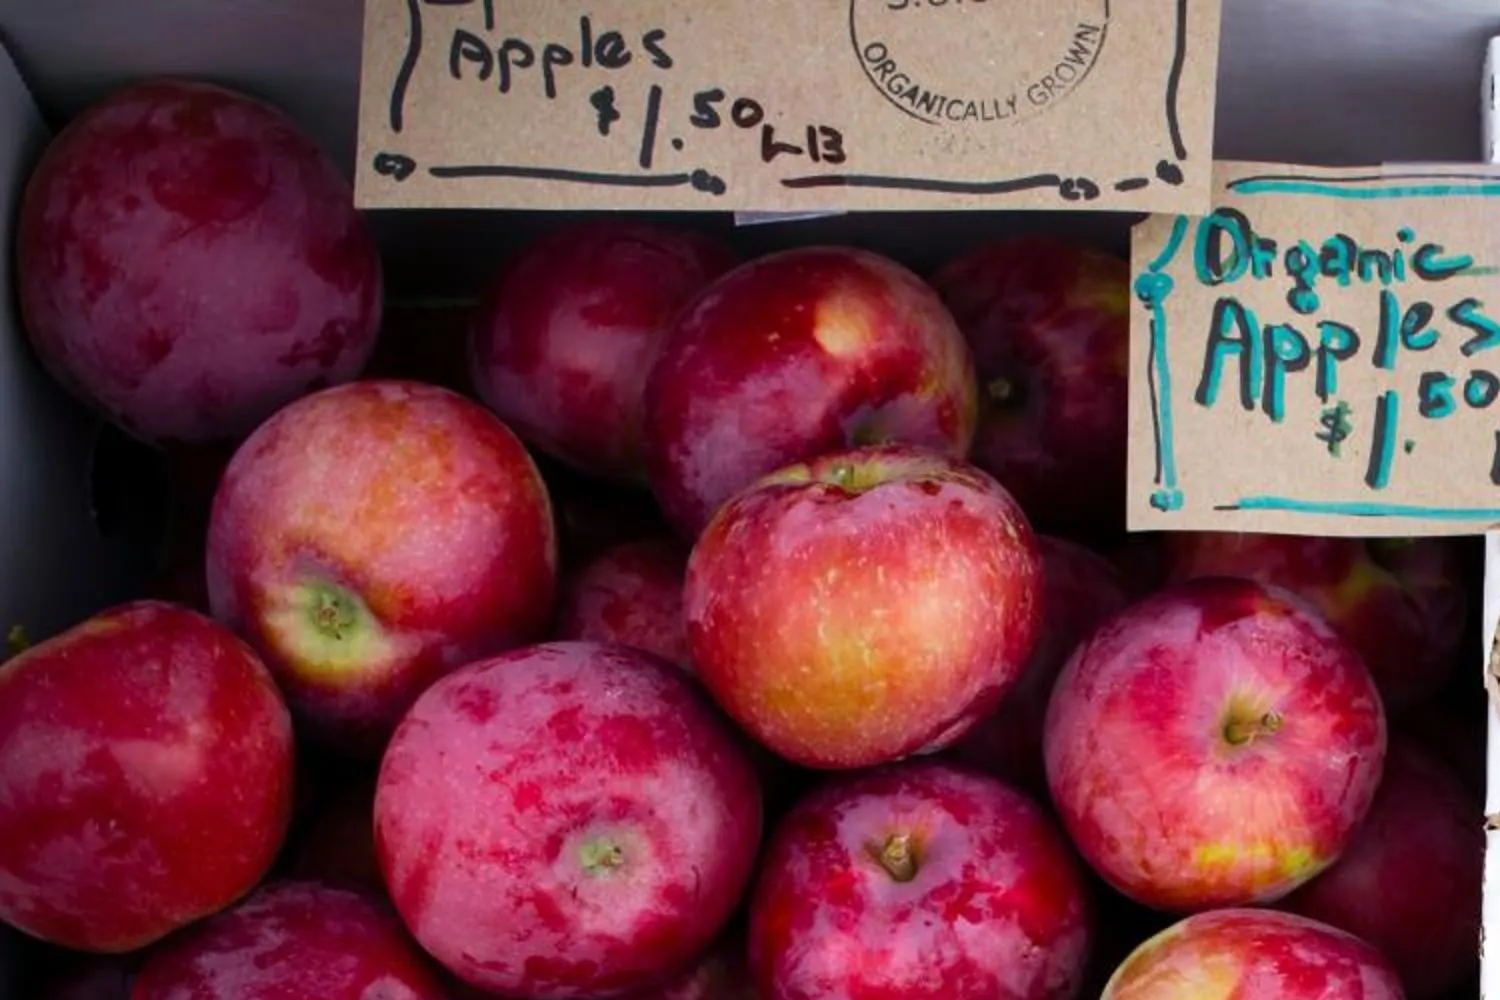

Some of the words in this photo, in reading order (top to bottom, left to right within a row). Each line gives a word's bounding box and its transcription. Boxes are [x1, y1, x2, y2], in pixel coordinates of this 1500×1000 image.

[448, 14, 674, 99] Apples
[863, 41, 1018, 122] ORGANICALLY
[1026, 22, 1100, 107] GROWN
[589, 84, 764, 169] $1.50
[1193, 206, 1475, 315] Organic
[1314, 368, 1500, 490] $1.50
